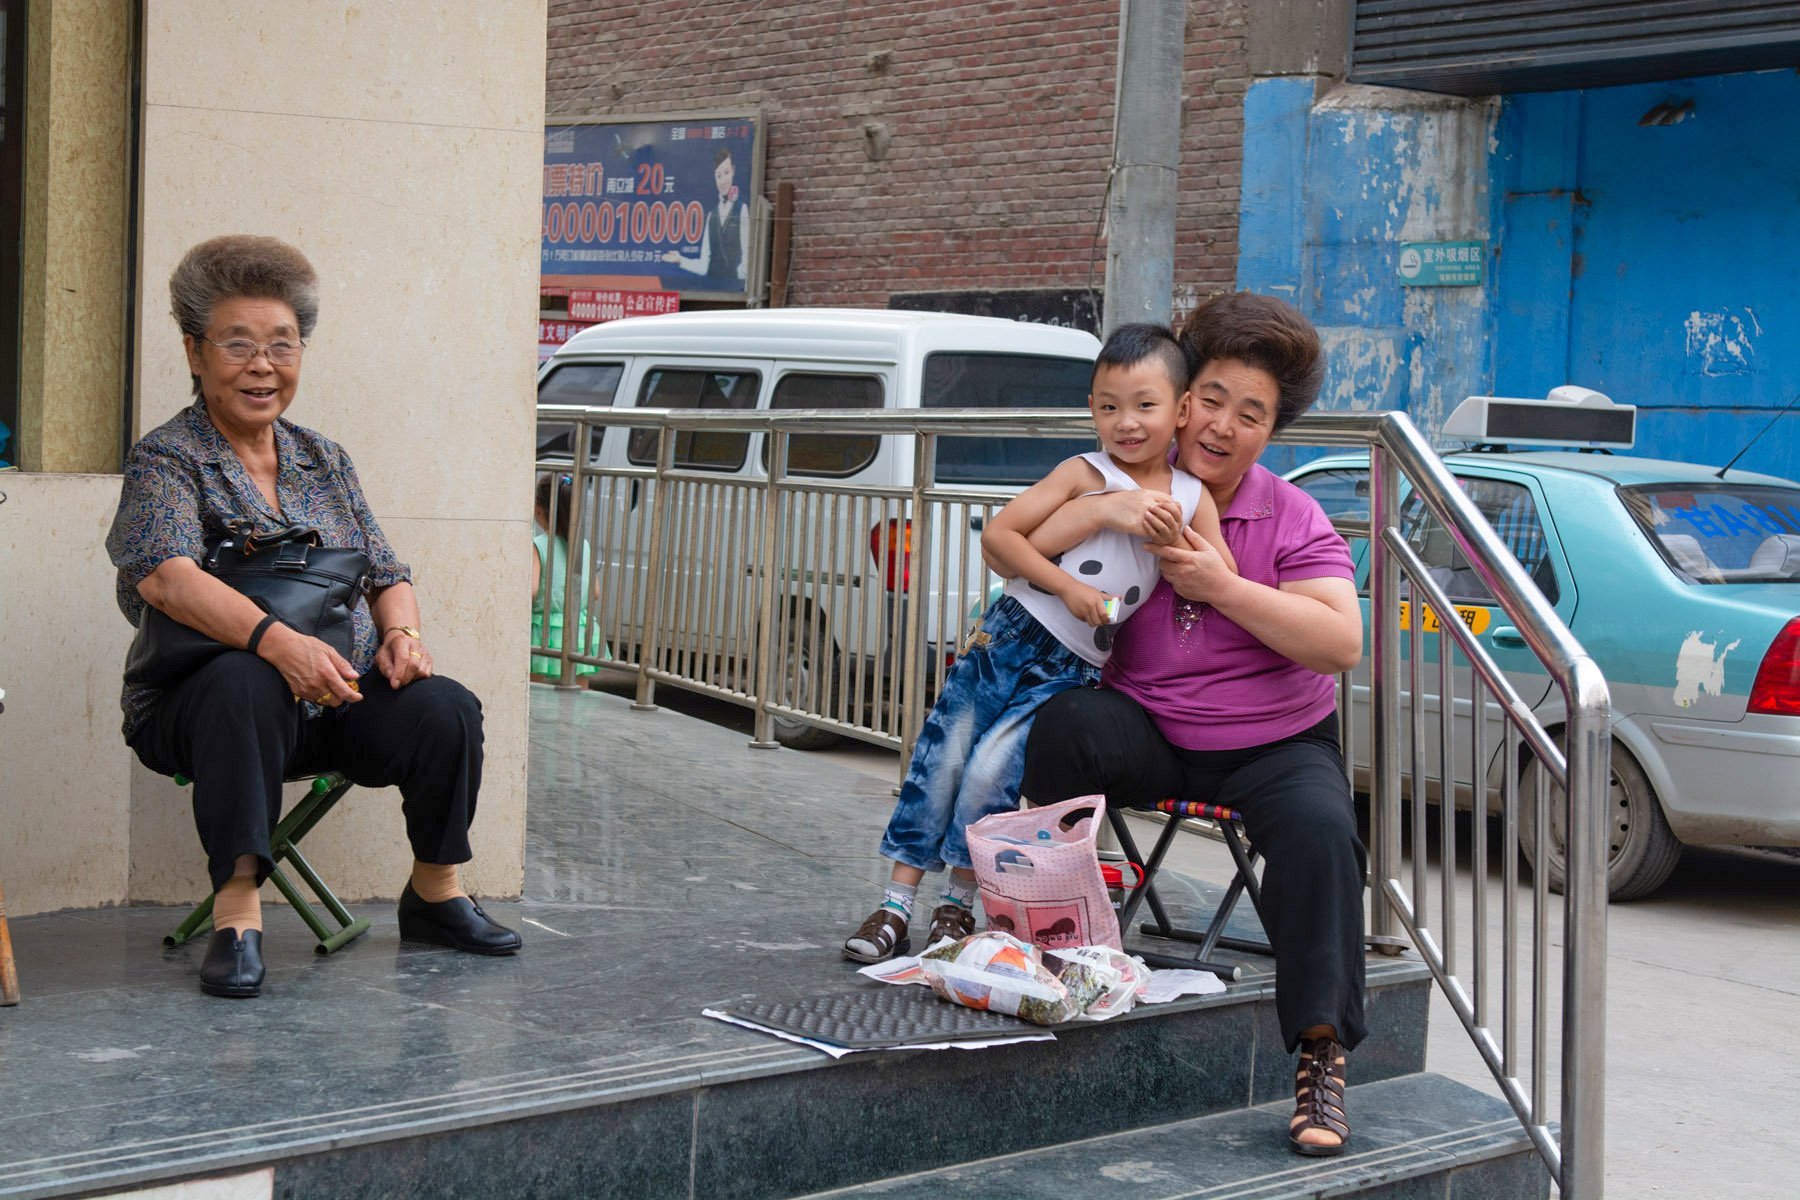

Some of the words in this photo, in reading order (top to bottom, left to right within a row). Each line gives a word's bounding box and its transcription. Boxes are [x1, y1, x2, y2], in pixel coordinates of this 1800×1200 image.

[1423, 247, 1480, 263] 室外吸烟区
[571, 302, 624, 319] 4000010000
[626, 295, 677, 312] 公益宣传栏
